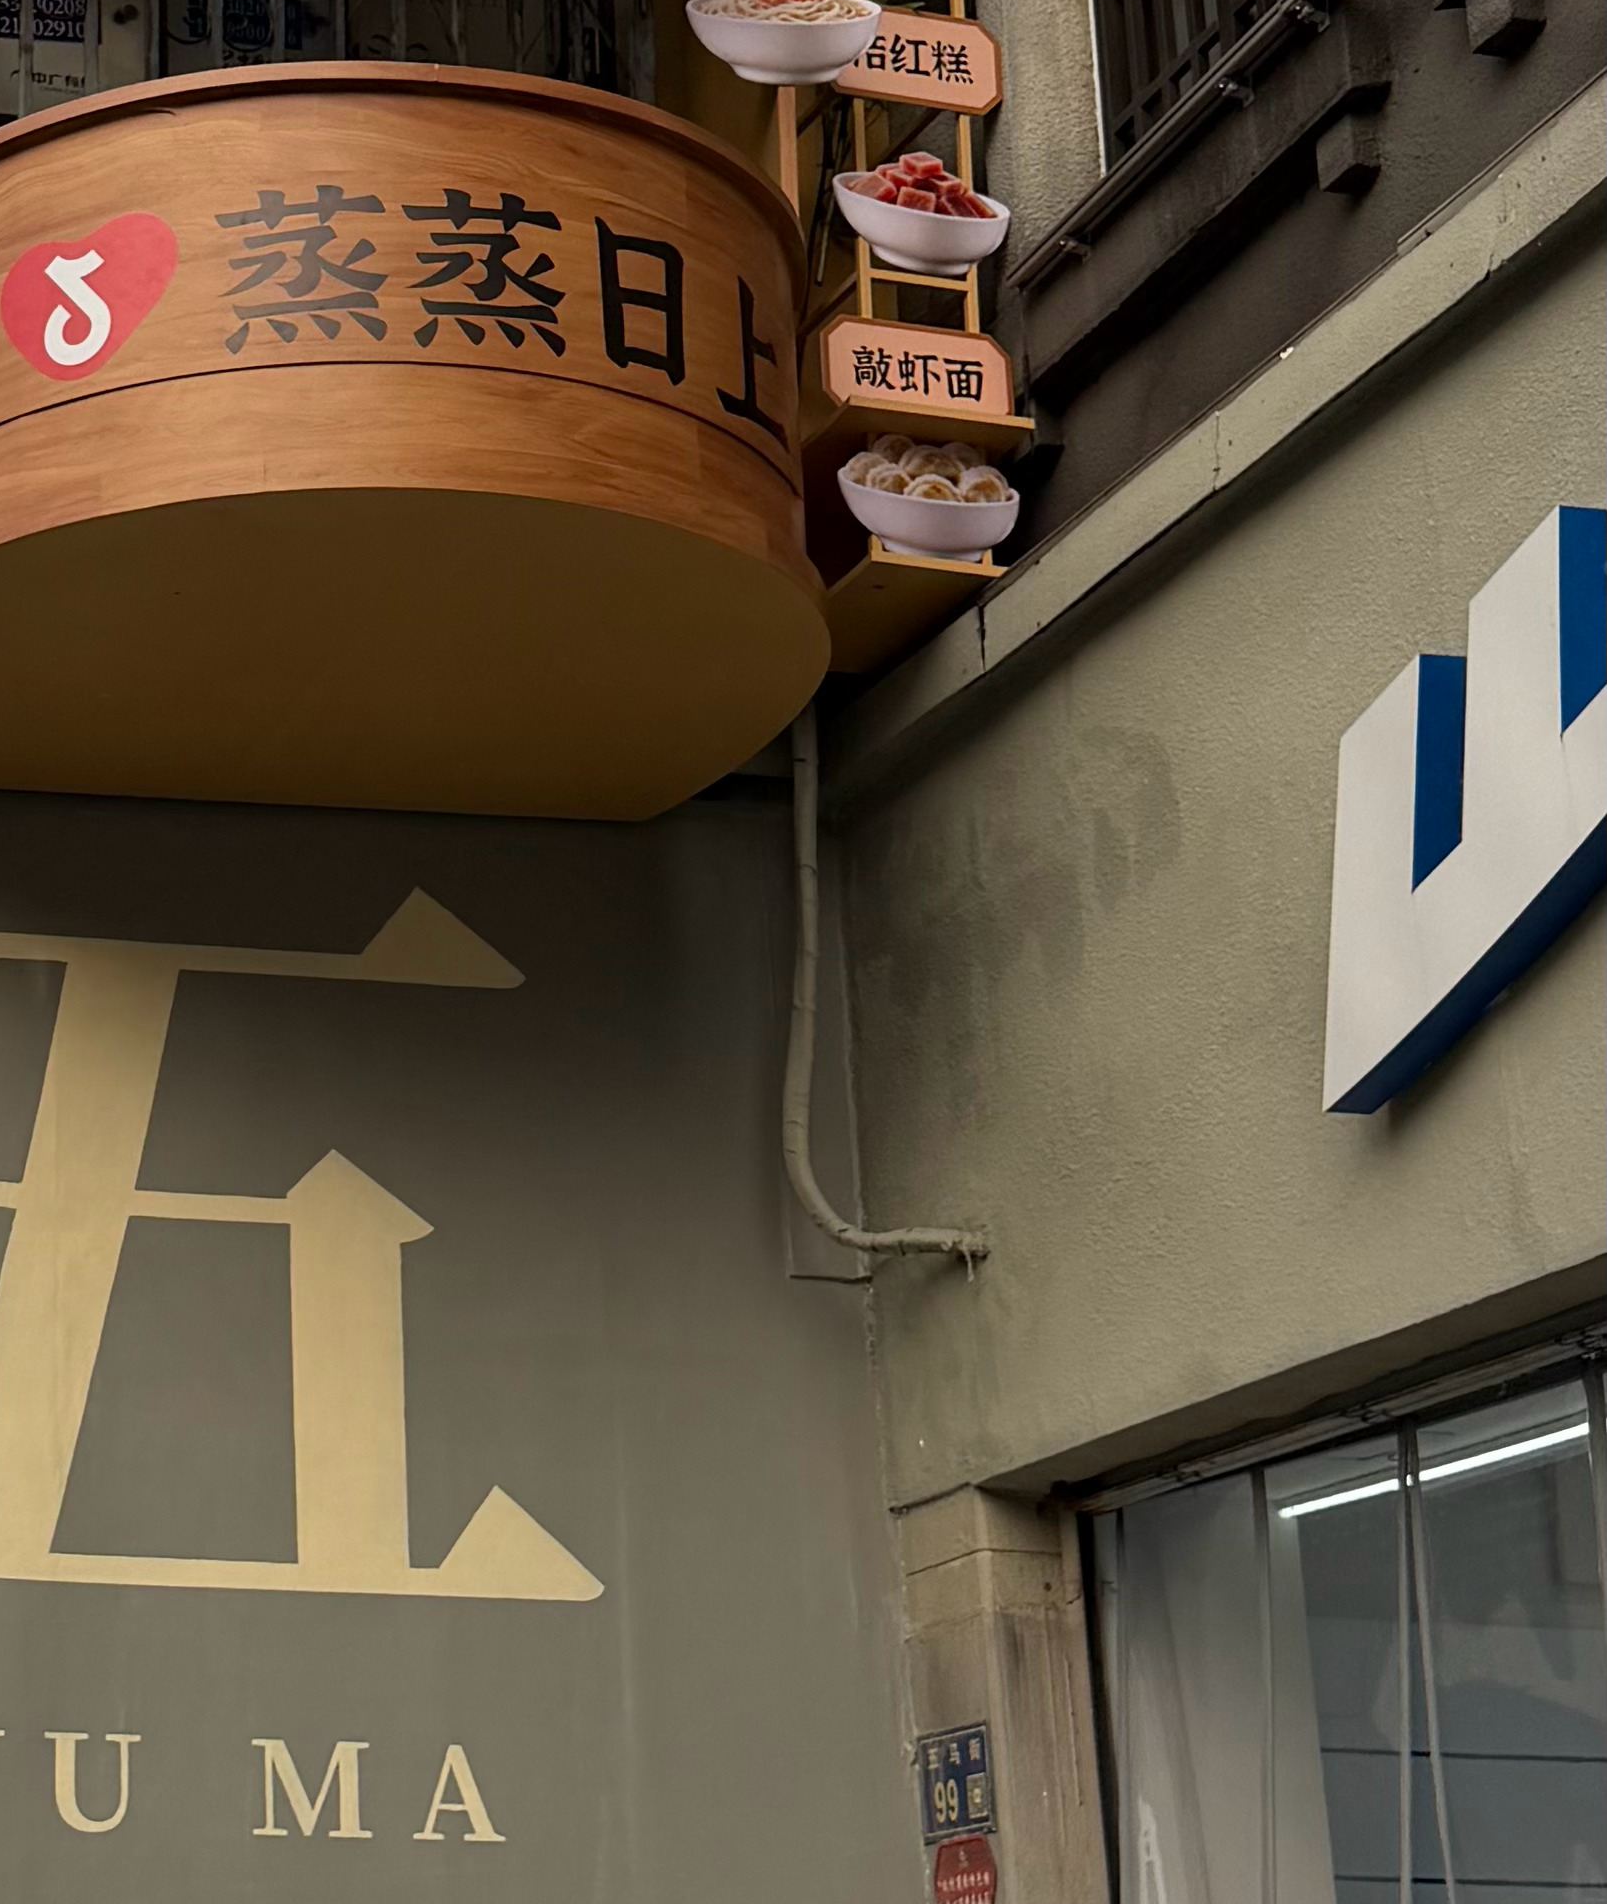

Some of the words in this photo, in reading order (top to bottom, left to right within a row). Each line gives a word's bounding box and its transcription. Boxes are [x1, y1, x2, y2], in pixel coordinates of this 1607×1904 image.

[213, 183, 790, 453] 蒸蒸日上
[851, 344, 985, 403] 敲虾面
